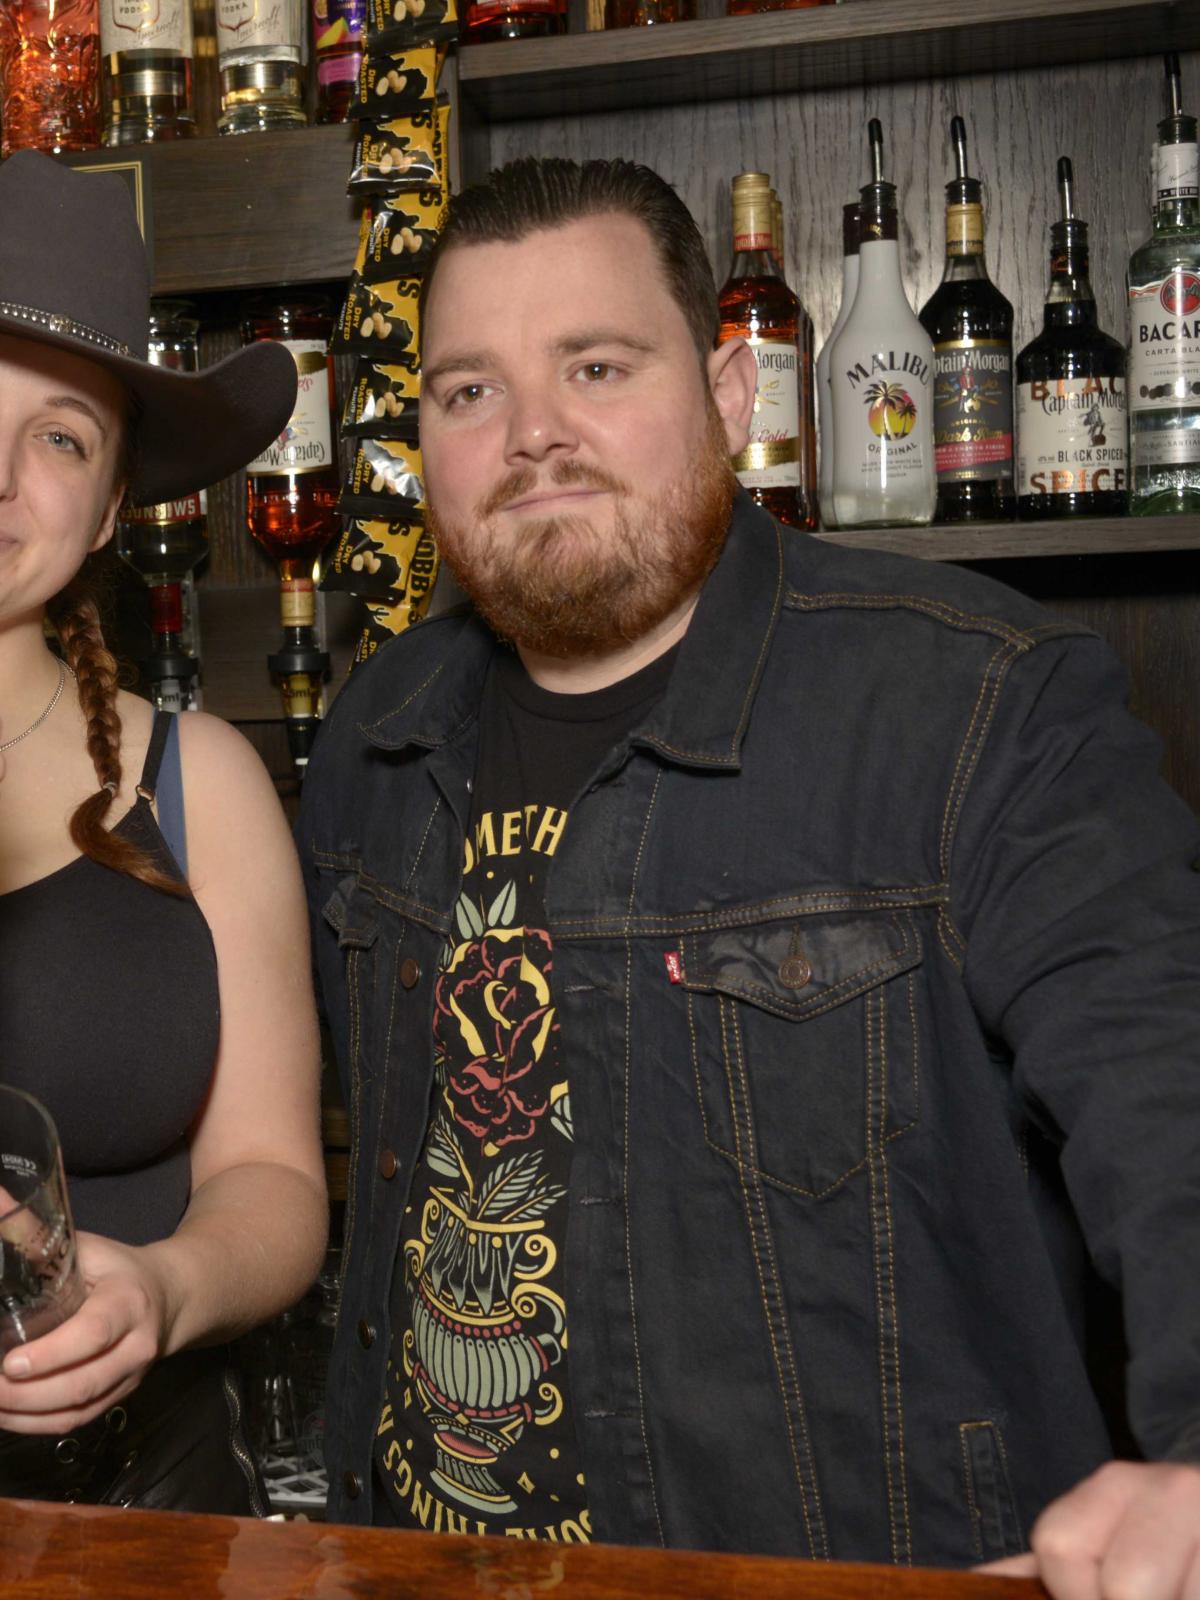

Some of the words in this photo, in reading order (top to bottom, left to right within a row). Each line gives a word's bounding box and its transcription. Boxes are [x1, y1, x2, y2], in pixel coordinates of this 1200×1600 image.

[359, 52, 369, 104] ROASTED
[367, 68, 377, 90] DRY
[383, 225, 392, 249] DRY
[342, 292, 357, 342] ROASTED
[353, 306, 363, 330] DRY
[1145, 346, 1177, 357] CARTA
[846, 351, 931, 390] MALIBU
[933, 351, 966, 378] ptain
[757, 428, 789, 443] Gold
[282, 441, 326, 464] Captan
[1057, 448, 1092, 463] BLACK
[362, 461, 372, 484] DRY
